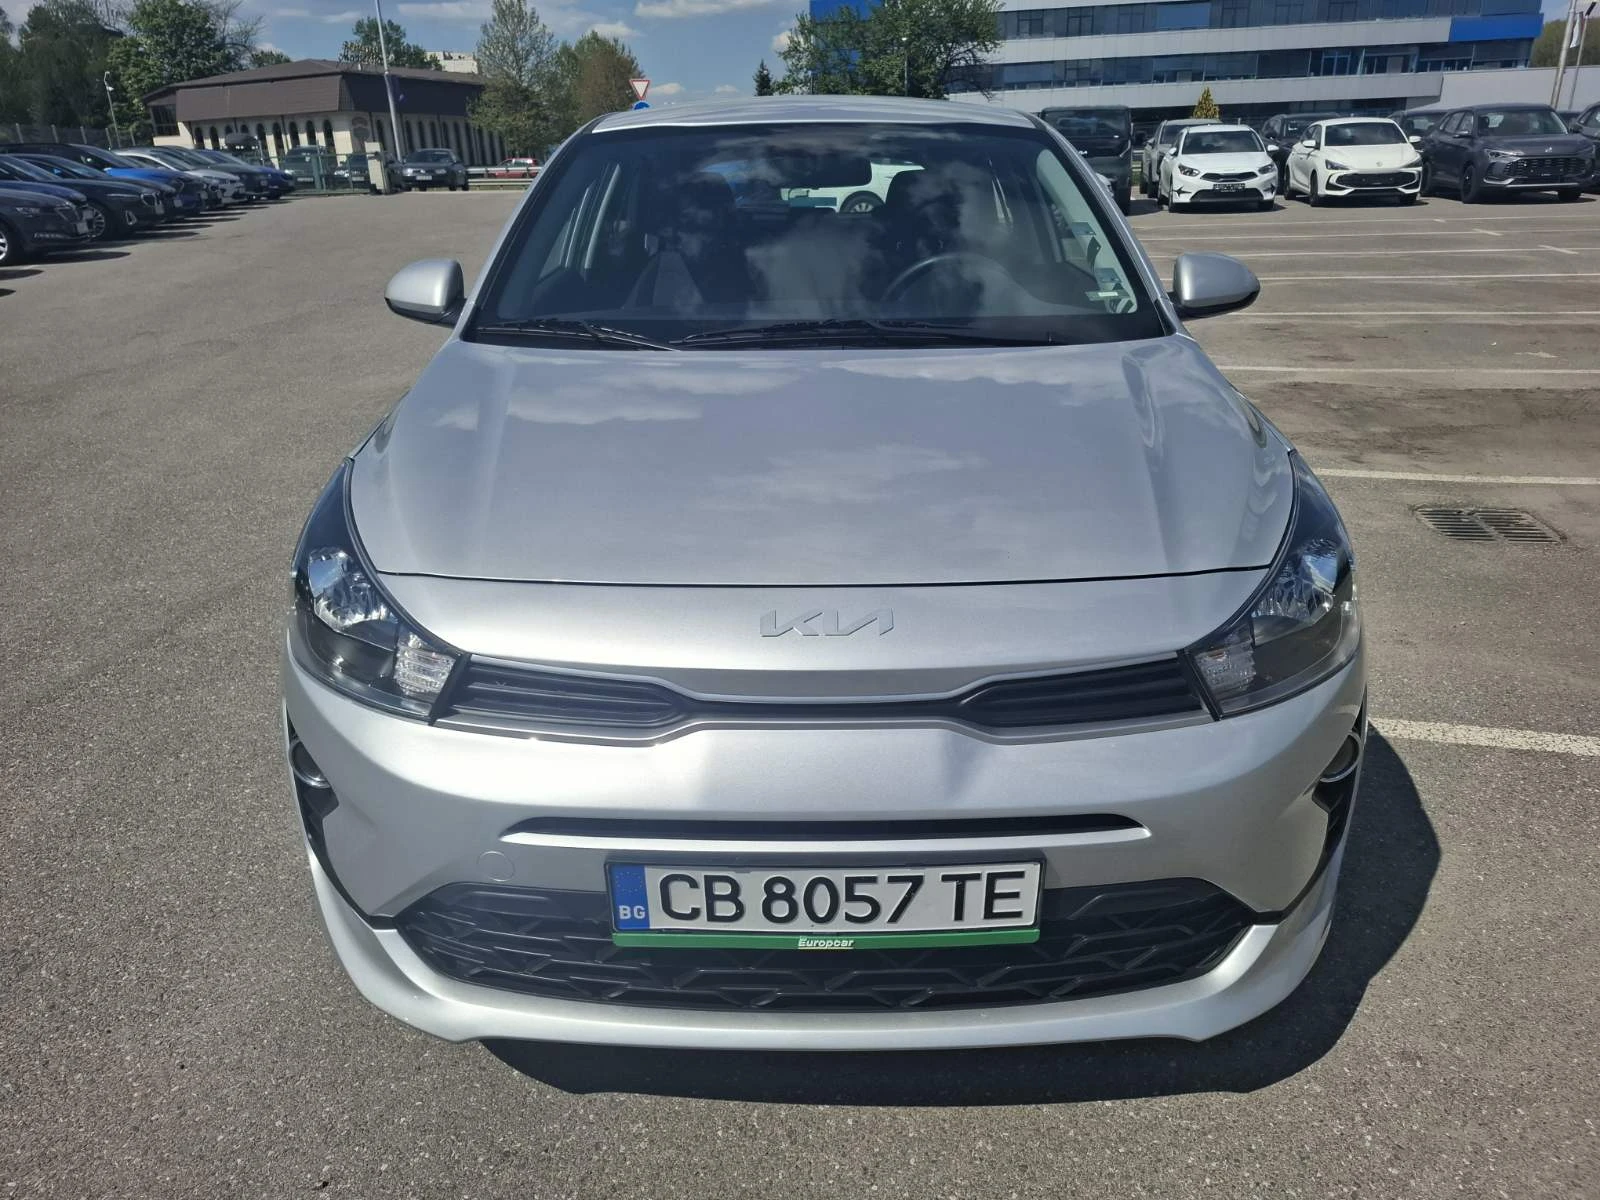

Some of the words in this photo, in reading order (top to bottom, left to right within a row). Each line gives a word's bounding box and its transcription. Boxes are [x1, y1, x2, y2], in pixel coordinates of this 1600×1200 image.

[759, 608, 894, 638] KIA
[658, 873, 744, 923] CB
[761, 874, 926, 925] 8057
[941, 870, 1026, 921] TE
[618, 905, 646, 920] BG
[798, 935, 854, 949] Europcar
